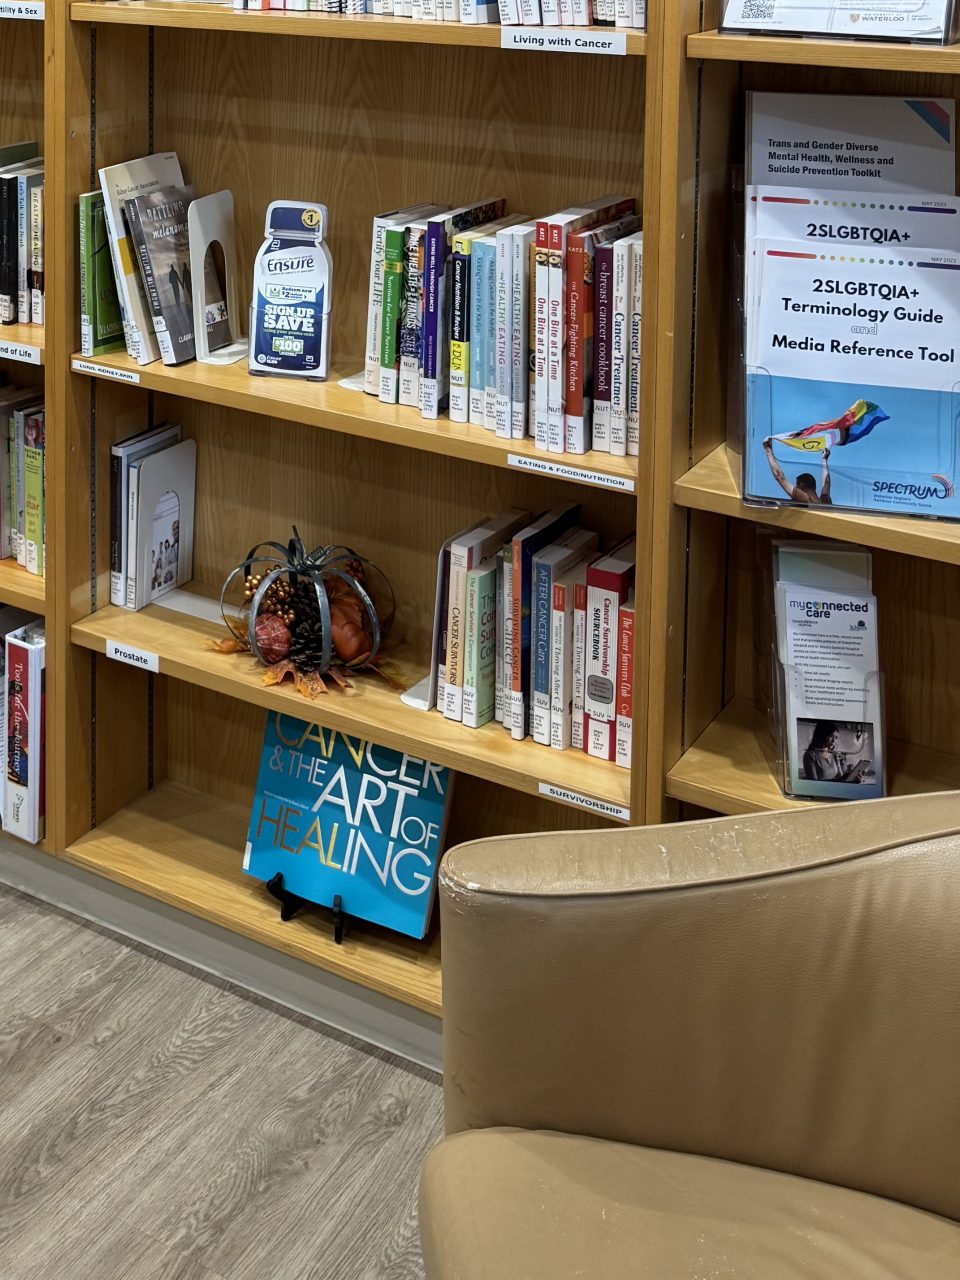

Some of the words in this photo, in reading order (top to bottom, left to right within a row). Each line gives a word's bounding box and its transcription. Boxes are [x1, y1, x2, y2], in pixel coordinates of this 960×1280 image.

[513, 34, 544, 47] Living
[548, 35, 572, 46] with
[574, 38, 612, 49] Cancer
[768, 138, 792, 149] Trans
[793, 139, 810, 149] and
[811, 140, 844, 151] Gender
[845, 142, 879, 152] Diverse
[768, 151, 799, 161] Mental
[801, 153, 833, 164] Health,
[835, 154, 875, 165] Wellness
[877, 155, 894, 165] and
[768, 164, 800, 174] Suicide
[802, 166, 849, 177] Prevention
[851, 167, 881, 178] Toolkit
[147, 200, 184, 221] BATTLING
[806, 223, 911, 244] 2SLGBTQIA+
[267, 257, 315, 273] Ensure
[599, 272, 610, 304] breast
[812, 278, 920, 301] 2SLGBTQIA+
[265, 304, 292, 316] SIGN
[296, 308, 315, 318] UP
[550, 300, 560, 317] One
[782, 297, 889, 323] Terminology
[893, 306, 944, 324] Guide
[263, 316, 315, 332] SAVE
[550, 320, 560, 338] Bite
[569, 292, 578, 357] Cancer-Fighting
[599, 306, 608, 340] cancer
[850, 323, 878, 336] and
[10, 347, 17, 355] of
[19, 348, 32, 358] Life
[275, 340, 301, 352] $100
[550, 340, 559, 351] at
[771, 334, 825, 352] Media
[830, 339, 914, 360] Reference
[918, 346, 955, 363] Tool
[550, 359, 560, 381] Time
[569, 360, 579, 391] Kitchen
[597, 342, 610, 392] cookbook
[518, 459, 546, 469] EATING
[556, 466, 625, 486] FOOD/NUTRITION
[872, 481, 948, 500] SPECTRUM
[603, 598, 612, 625] Cancer
[806, 609, 831, 619] care
[592, 607, 600, 661] SOURCEBOOK
[114, 647, 148, 665] Prostate
[601, 627, 611, 676] Survivorship
[14, 663, 23, 691] Tools
[14, 693, 22, 709] for
[14, 712, 22, 726] the
[13, 731, 22, 774] Journey
[275, 713, 445, 796] CANCER
[269, 745, 284, 773] &
[288, 749, 328, 787] THE
[311, 764, 419, 839] ART
[401, 816, 439, 849] OF
[549, 787, 622, 816] SURVIVORSHIP
[256, 799, 432, 896] HEALING
